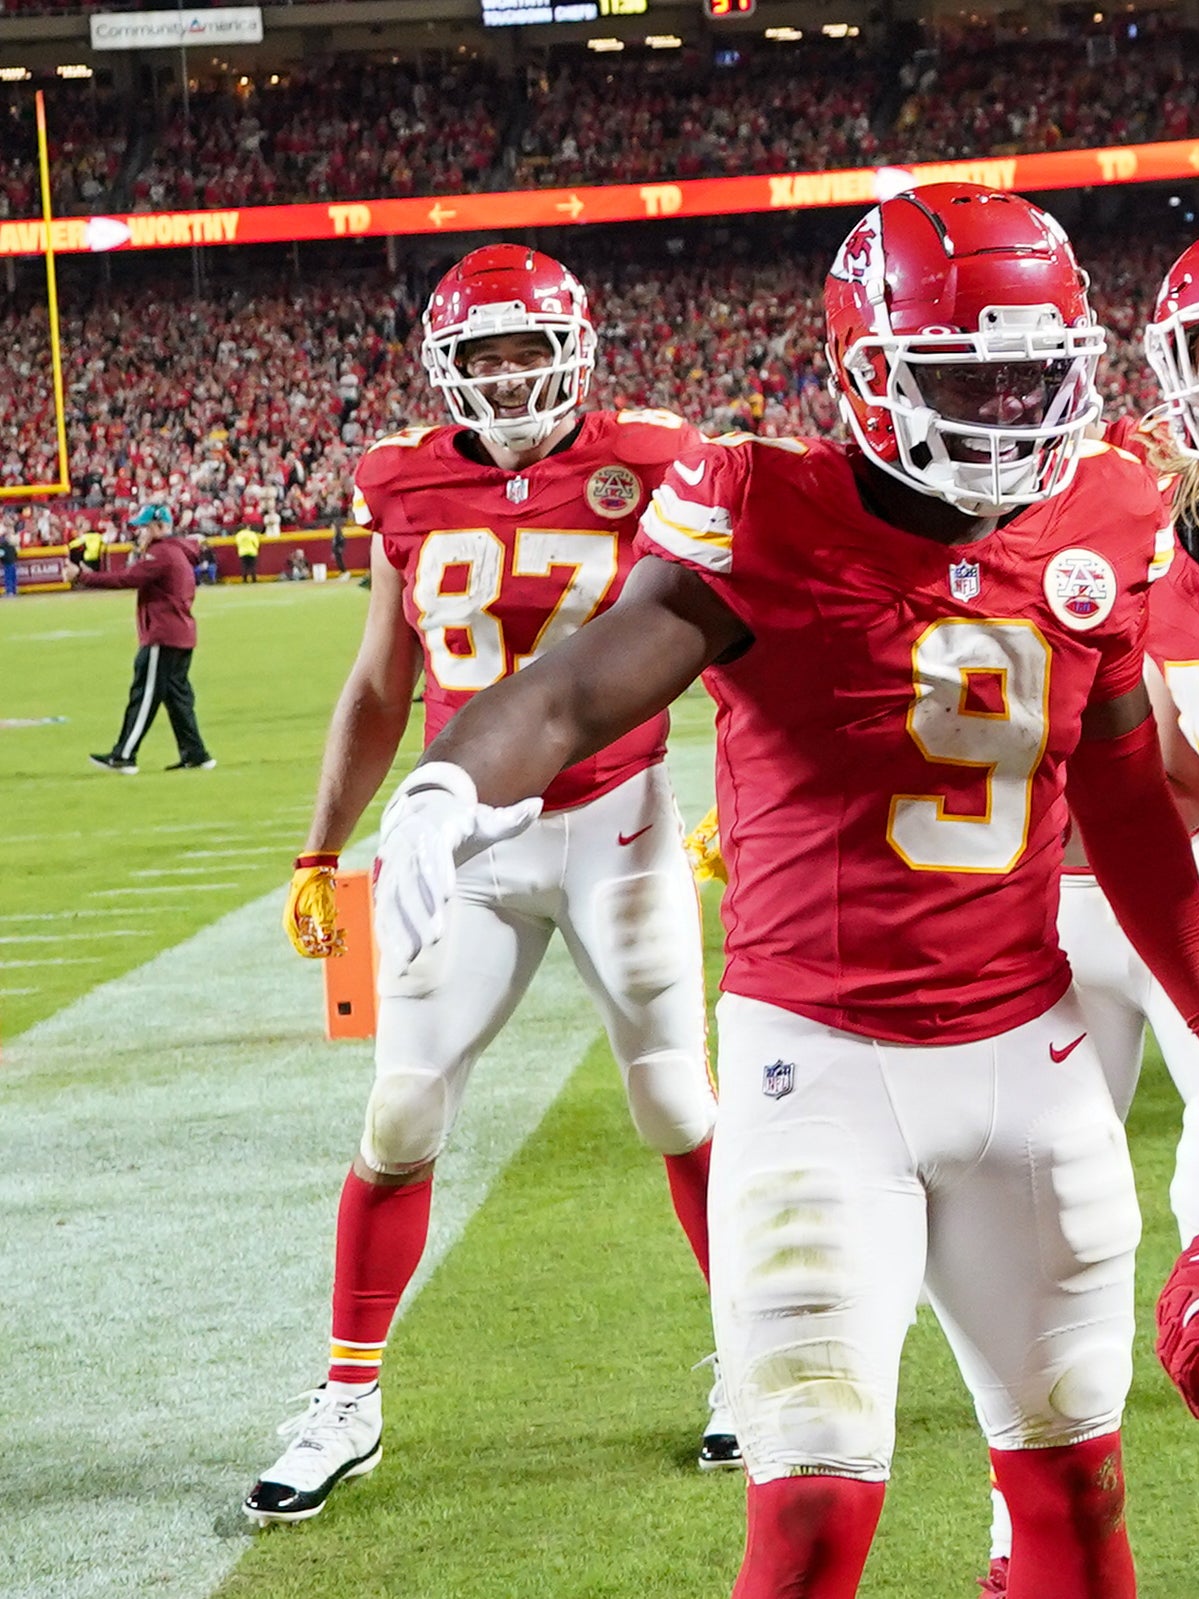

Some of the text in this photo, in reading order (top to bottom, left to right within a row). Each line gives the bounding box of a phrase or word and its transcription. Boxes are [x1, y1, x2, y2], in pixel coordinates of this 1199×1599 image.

[1097, 149, 1137, 182] TD
[640, 184, 682, 216] TD
[769, 170, 876, 207] XAVIER
[128, 211, 239, 247] WORTHY
[328, 204, 371, 235] TD
[413, 527, 619, 692] 87
[885, 616, 1053, 874] 9
